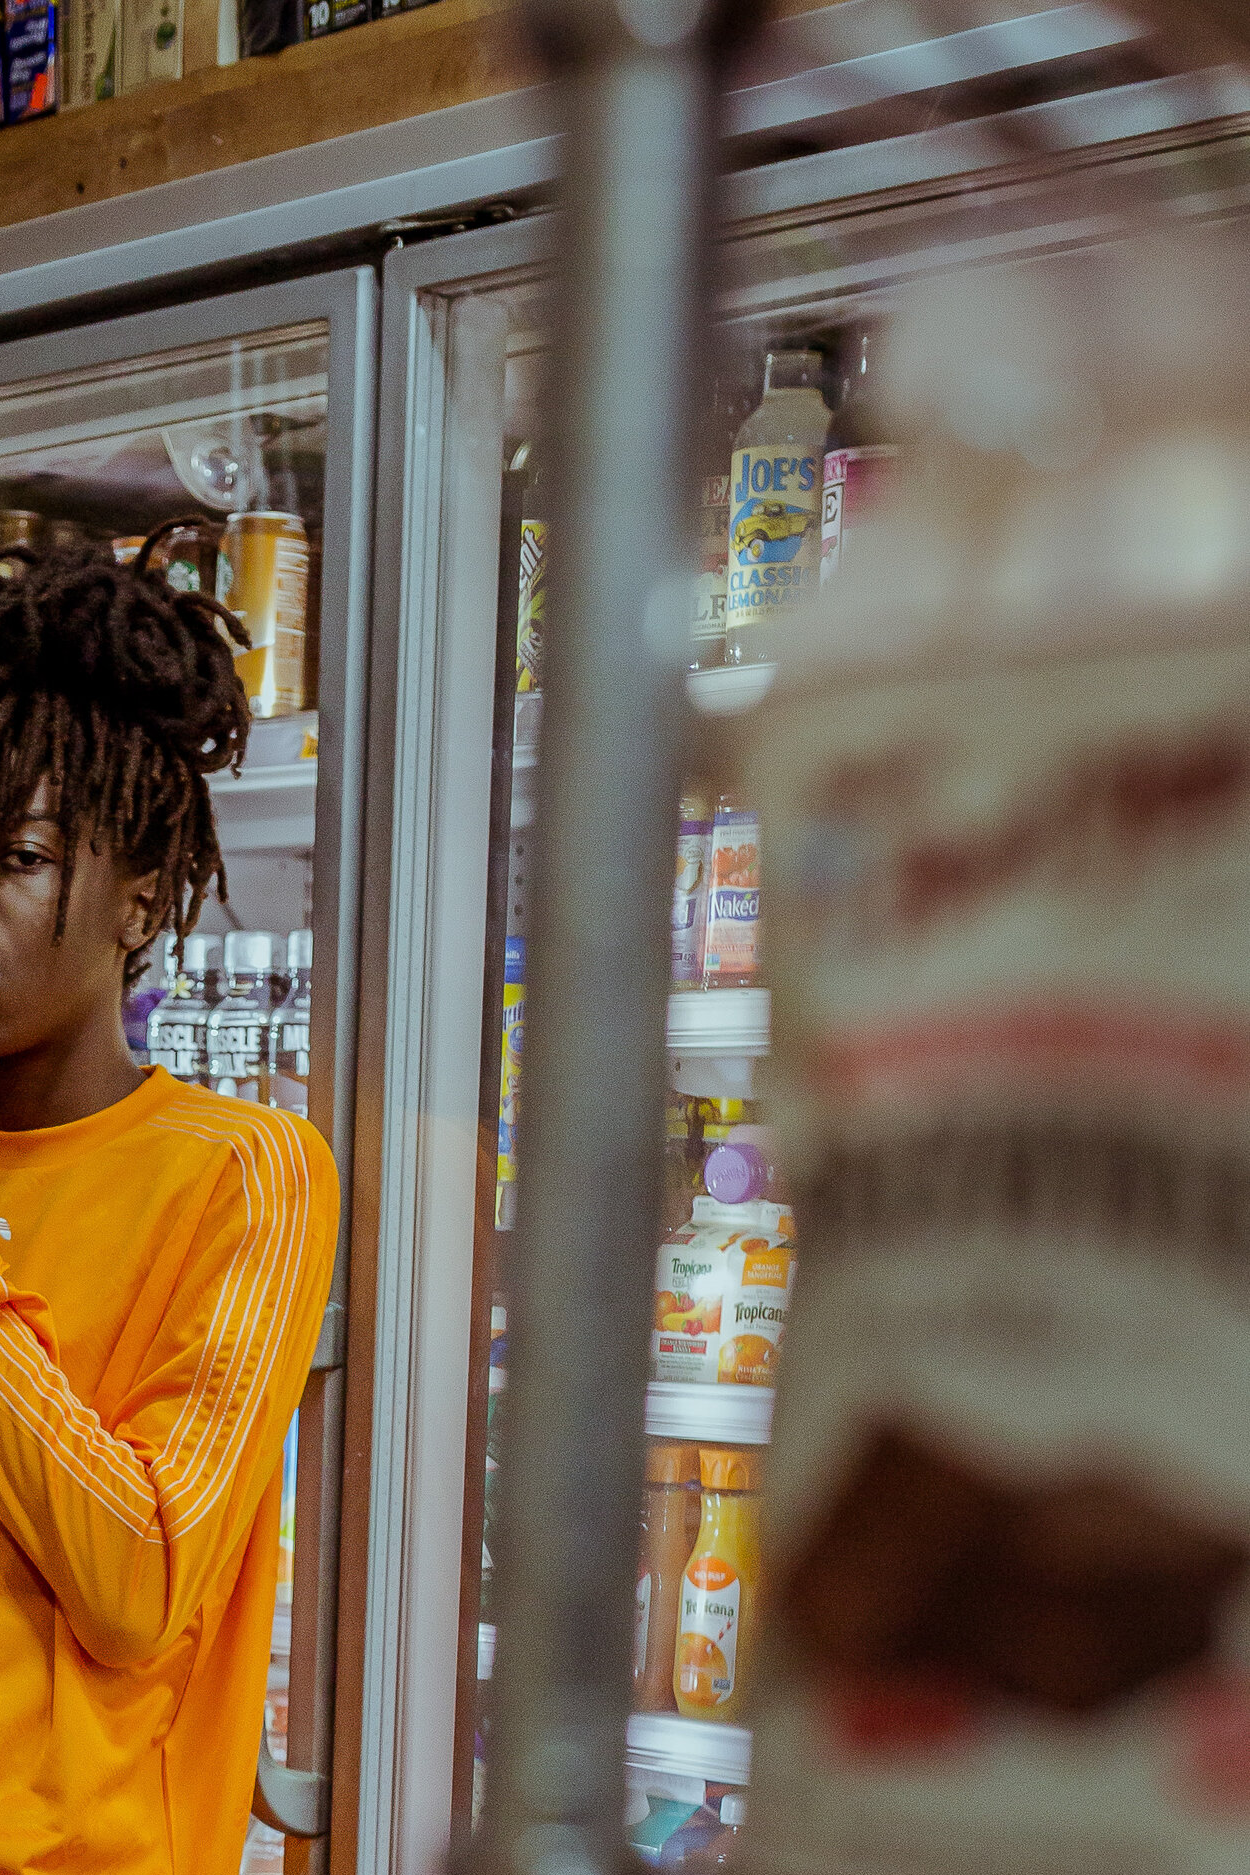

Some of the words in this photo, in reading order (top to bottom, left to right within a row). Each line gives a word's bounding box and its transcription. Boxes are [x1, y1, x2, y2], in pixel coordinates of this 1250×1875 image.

[734, 454, 815, 502] JOE'S
[730, 566, 813, 592] CLASSI
[728, 588, 802, 611] LEMONA
[713, 893, 760, 920] Naked
[685, 1600, 735, 1617] Troicana
